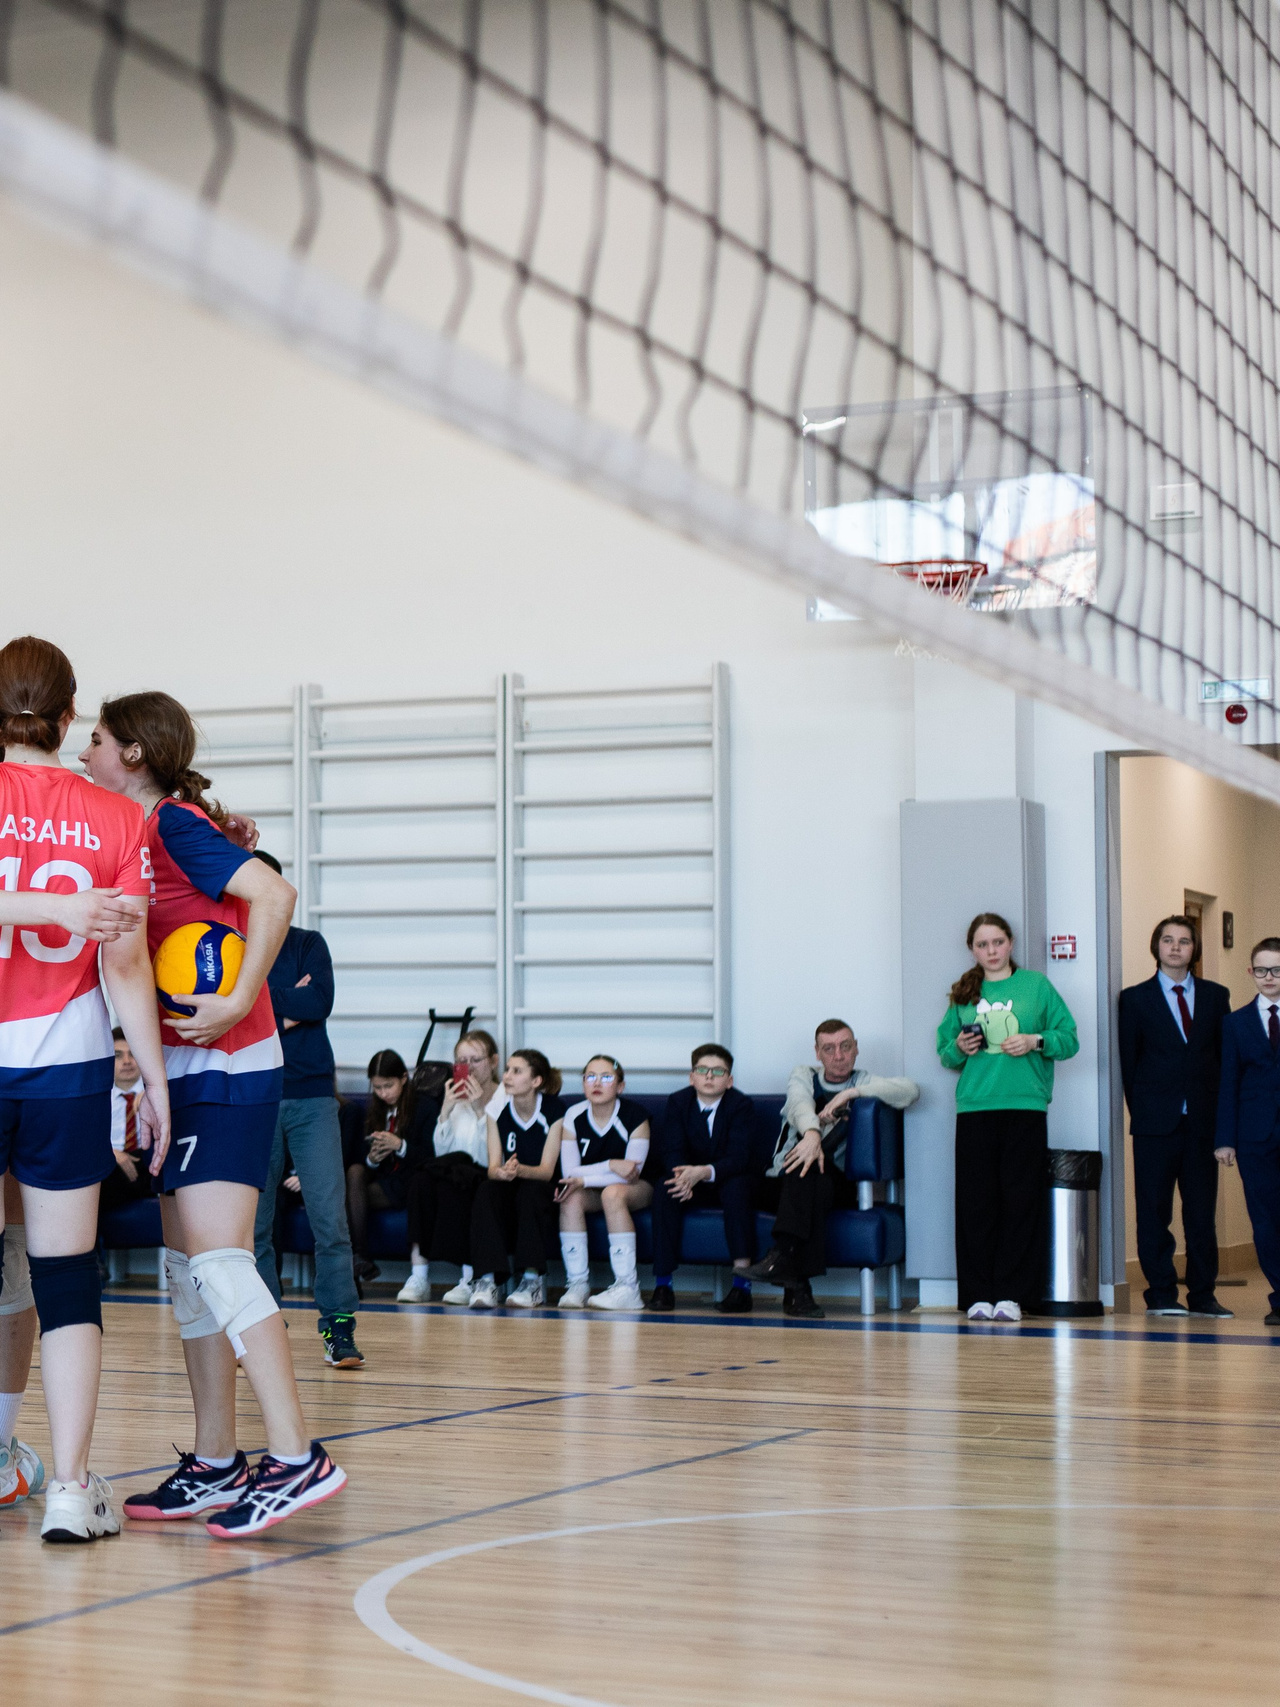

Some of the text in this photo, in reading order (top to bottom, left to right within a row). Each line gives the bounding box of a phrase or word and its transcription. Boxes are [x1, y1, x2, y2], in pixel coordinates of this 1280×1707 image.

[506, 1131, 517, 1153] 6
[580, 1137, 591, 1158] 7
[176, 1135, 198, 1172] 7
